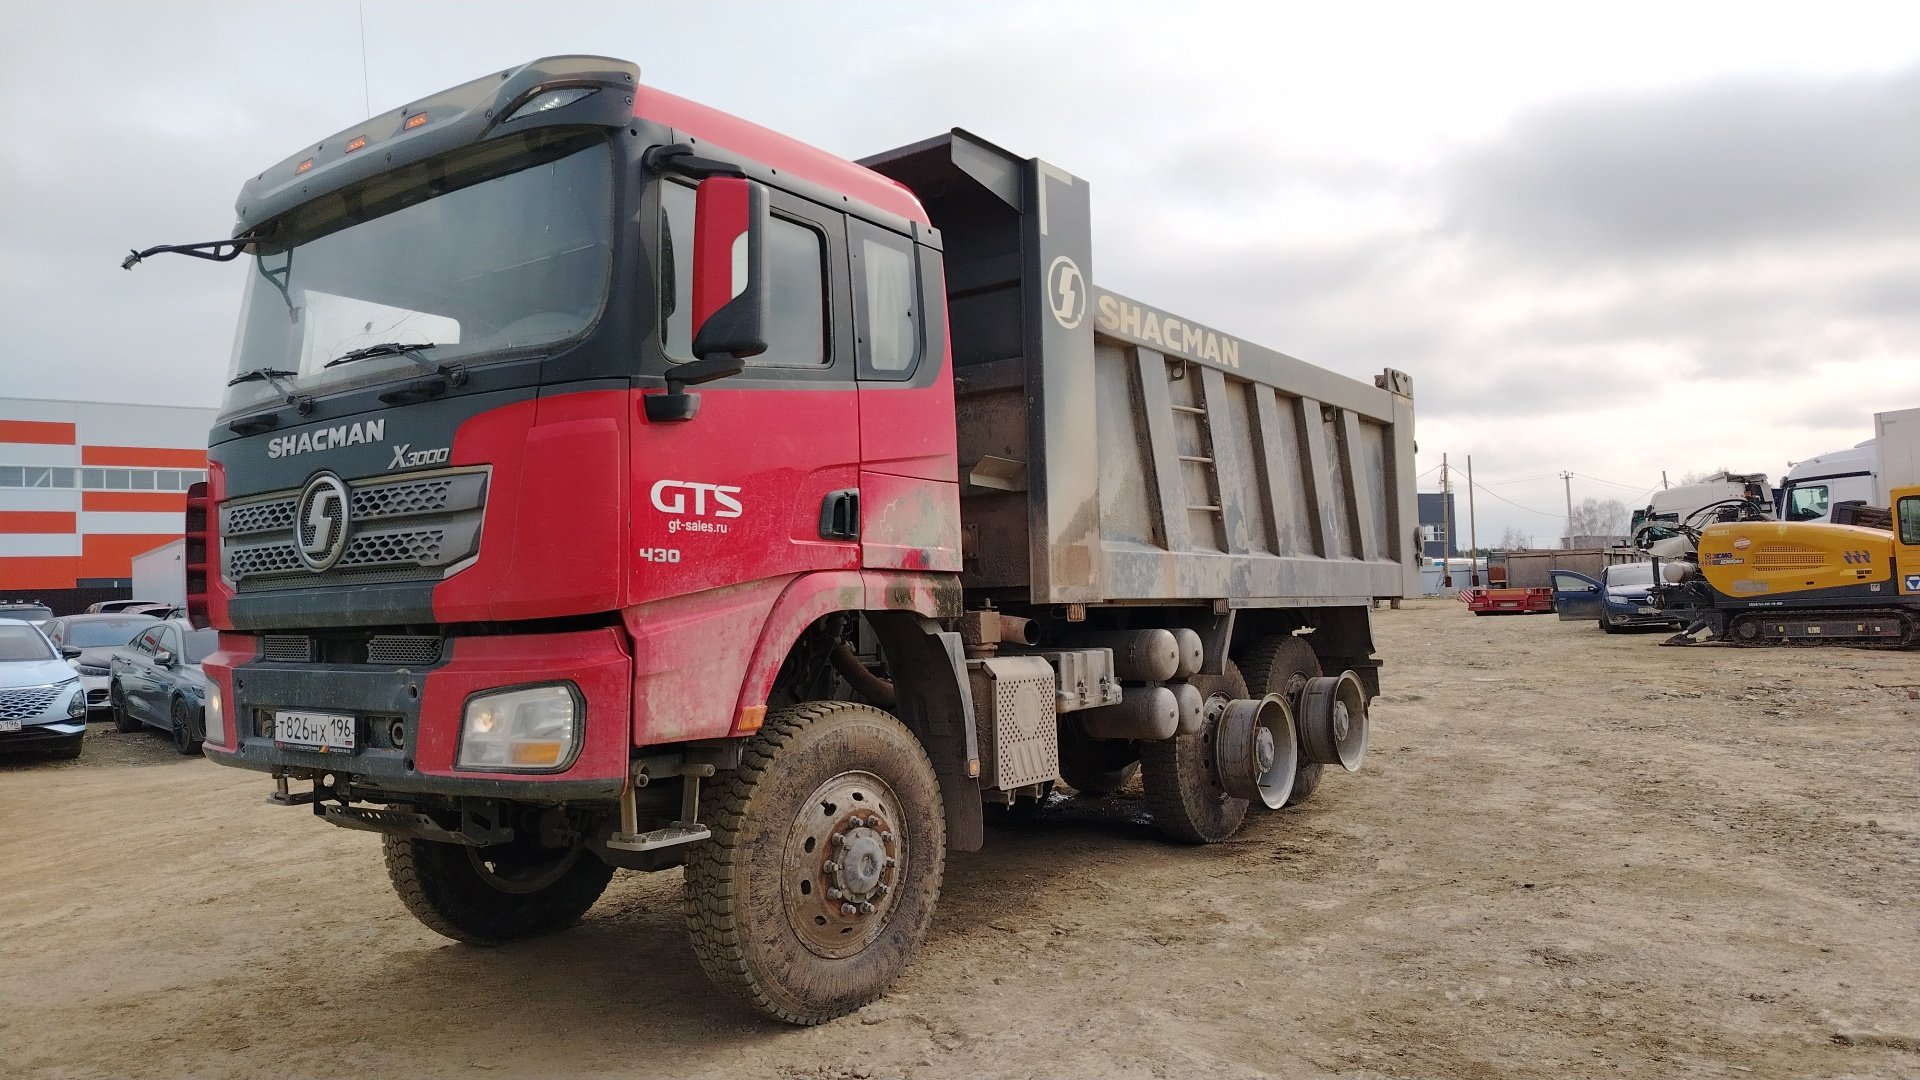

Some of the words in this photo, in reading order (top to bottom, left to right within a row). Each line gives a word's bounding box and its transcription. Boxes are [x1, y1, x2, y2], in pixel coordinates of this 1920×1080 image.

[1099, 294, 1239, 369] SHACMAN
[268, 418, 385, 459] SHACMAN
[387, 443, 450, 470] X3000
[650, 479, 743, 518] GTS
[668, 518, 728, 534] gt-sales.ru
[639, 548, 681, 563] 430
[330, 718, 351, 738] 196
